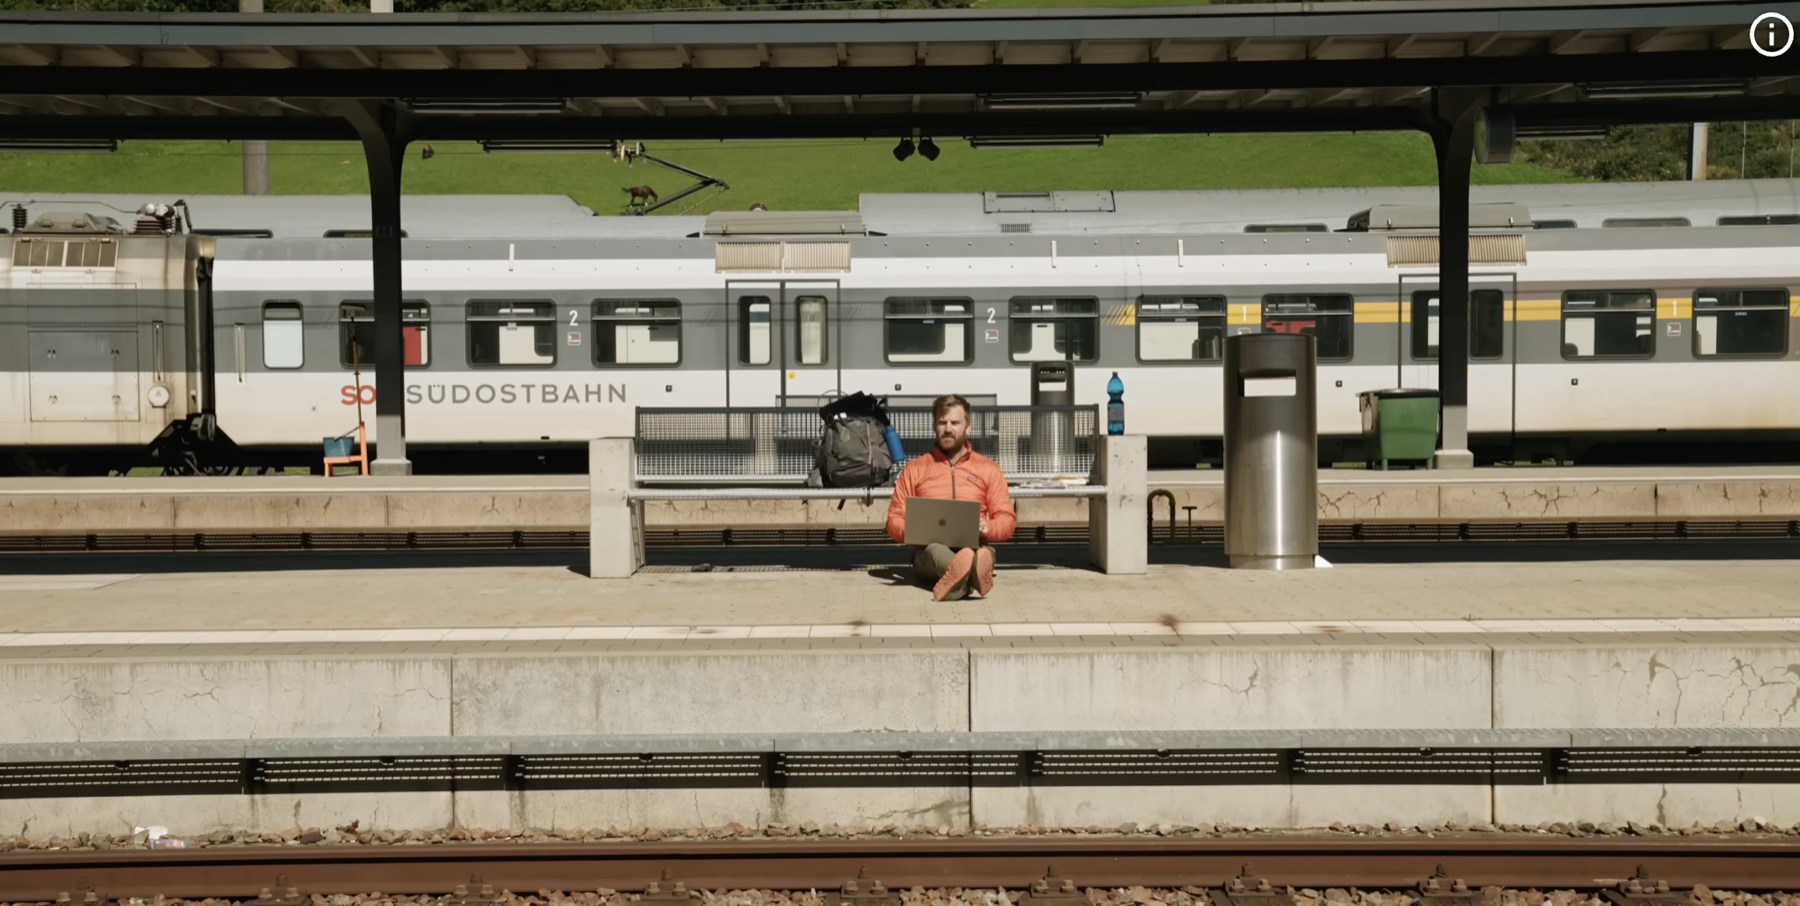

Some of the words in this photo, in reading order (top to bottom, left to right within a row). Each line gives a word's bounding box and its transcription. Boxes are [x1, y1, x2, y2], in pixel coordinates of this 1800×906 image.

[987, 307, 996, 324] 2
[1242, 305, 1247, 322] 1
[1672, 300, 1677, 316] 1
[569, 309, 578, 326] 2
[341, 384, 376, 405] SO
[406, 383, 627, 404] SÜDOSTBAHN
